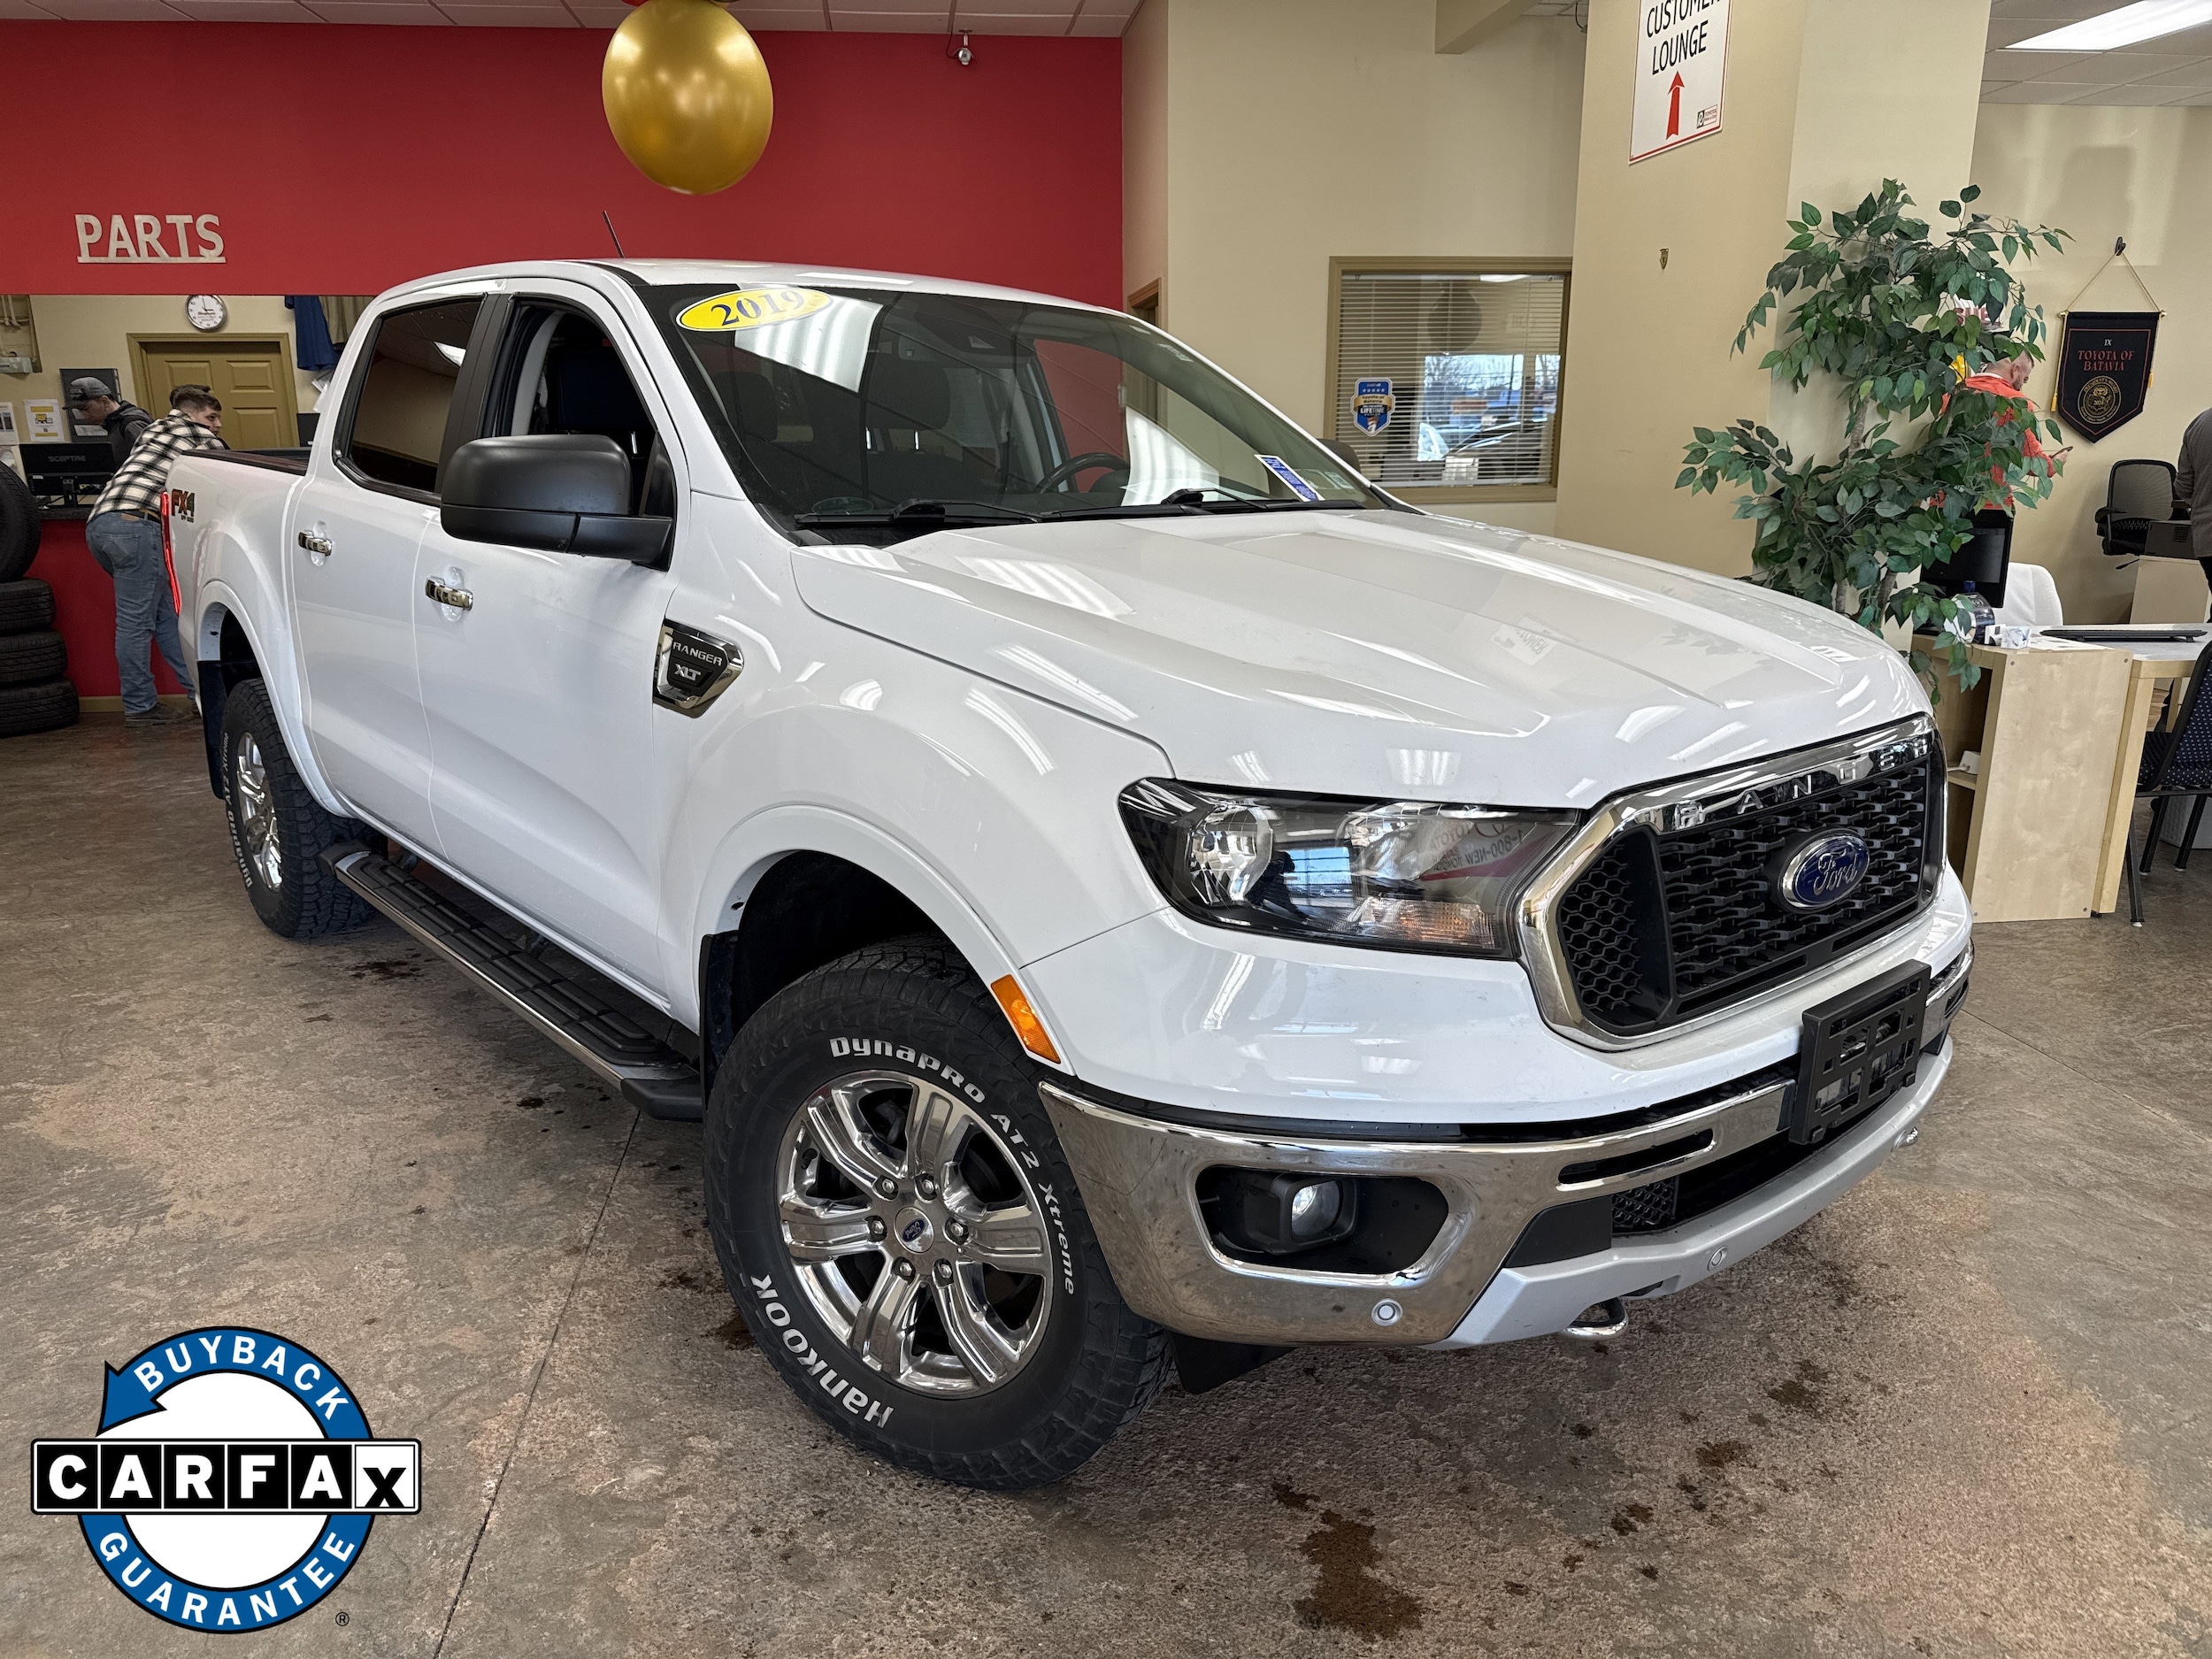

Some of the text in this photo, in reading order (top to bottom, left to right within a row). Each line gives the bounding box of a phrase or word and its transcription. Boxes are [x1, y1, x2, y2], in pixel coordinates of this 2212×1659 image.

[1647, 0, 1720, 38] CUSTOM
[1652, 19, 1709, 76] LOUNGE
[74, 213, 225, 258] PARTS
[710, 290, 805, 326] 2019
[2078, 350, 2134, 360] TOYOTA OF
[2084, 361, 2124, 371] BATAVIA
[171, 488, 196, 518] FX4
[672, 641, 724, 667] RANGER
[673, 663, 702, 682] XLT
[1813, 848, 1860, 896] Ford
[990, 1113, 1041, 1169] AT2
[1037, 1182, 1075, 1295] Xtreme
[904, 1221, 921, 1240] Ford
